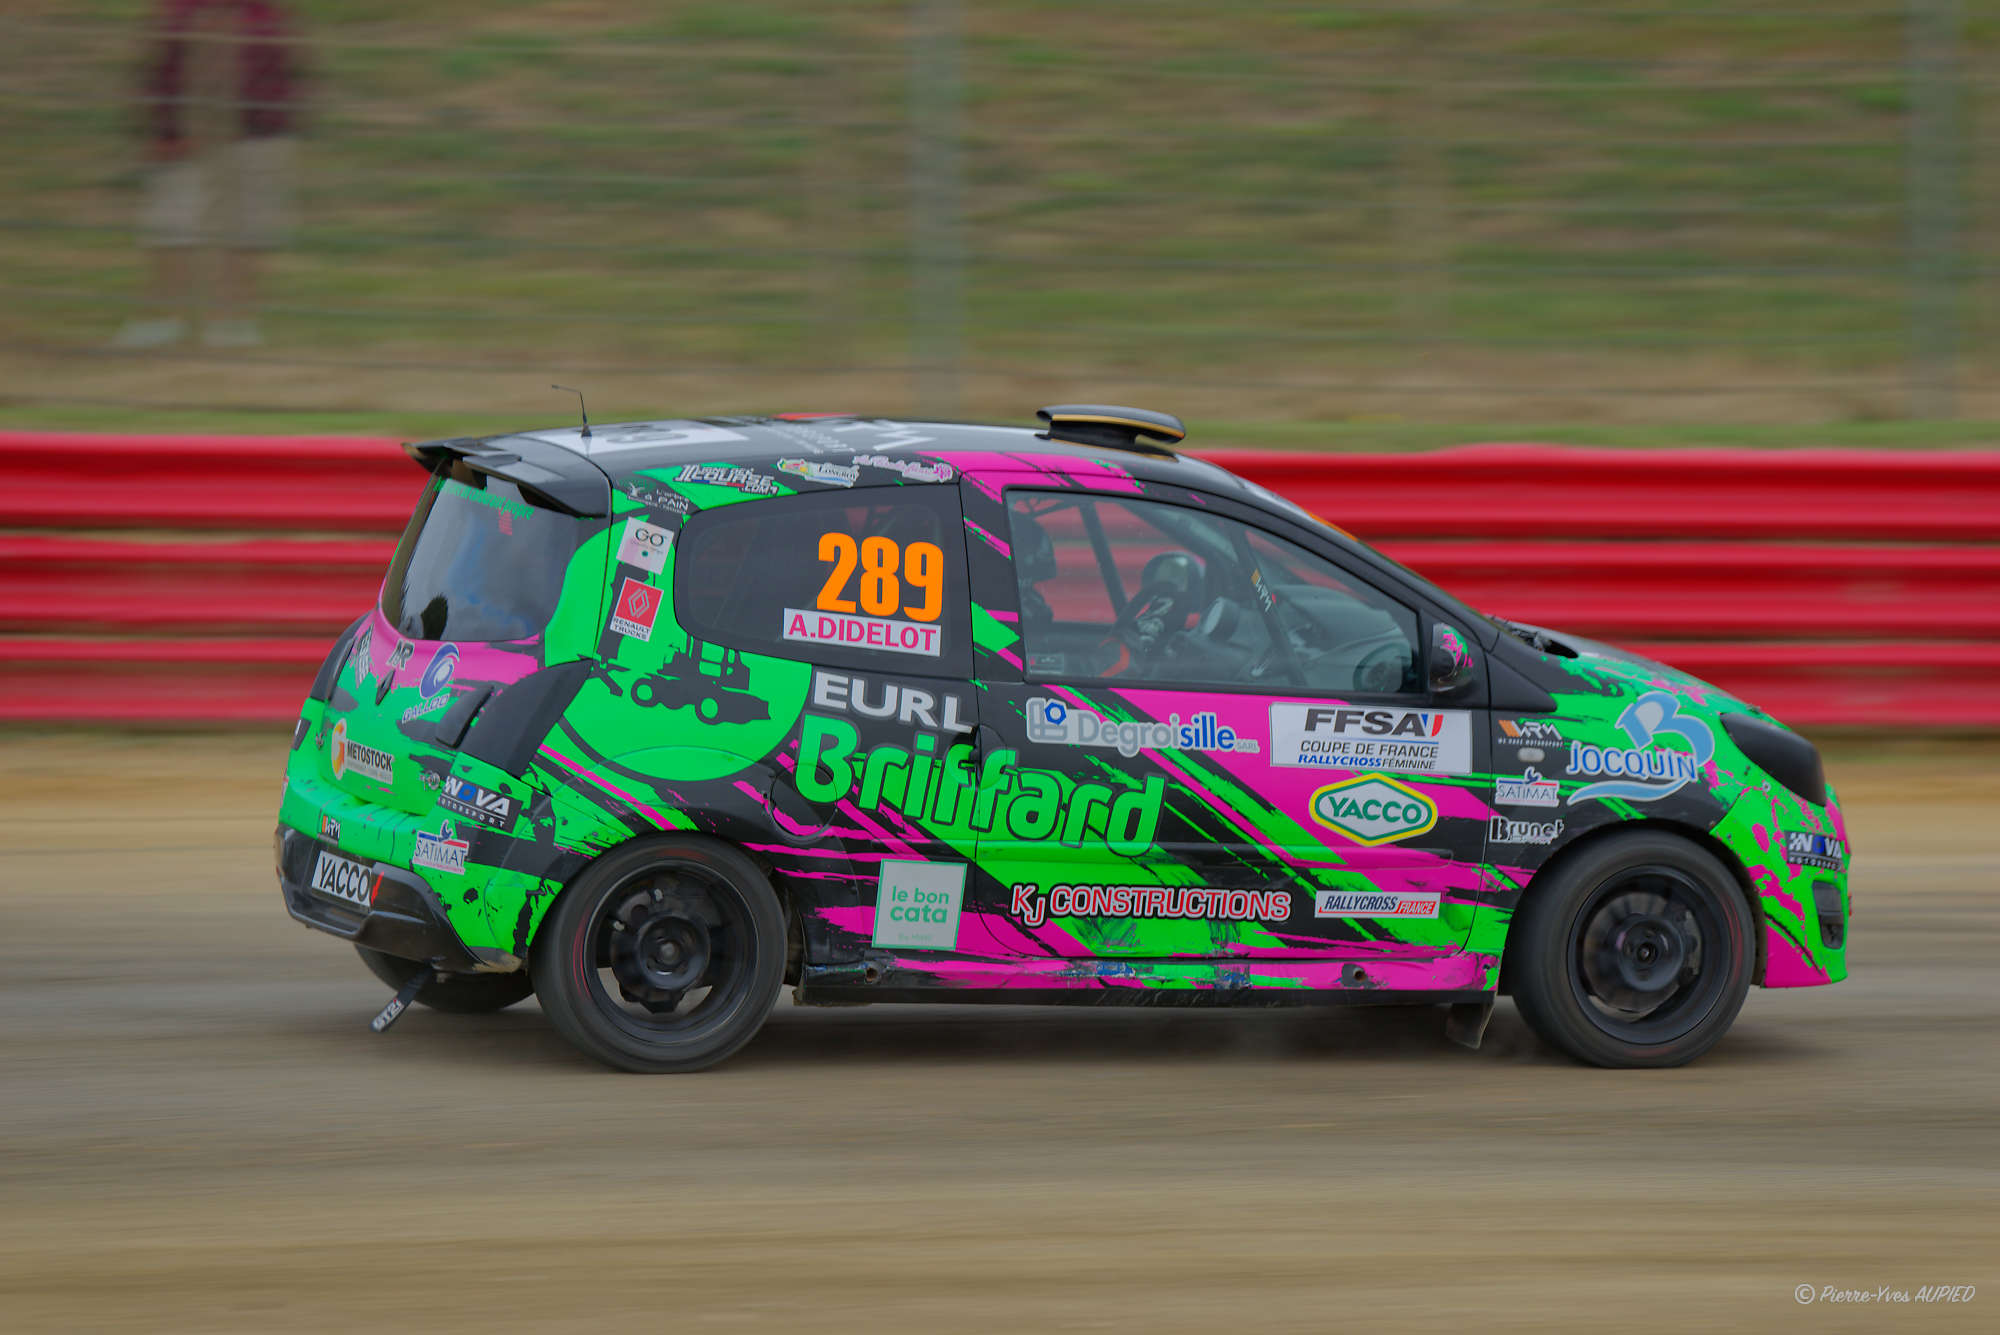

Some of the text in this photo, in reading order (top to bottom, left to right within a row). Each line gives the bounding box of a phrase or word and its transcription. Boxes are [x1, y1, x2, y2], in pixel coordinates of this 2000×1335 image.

[658, 496, 690, 511] PAIN
[635, 528, 665, 546] GO
[817, 532, 943, 622] 289
[613, 617, 650, 633] RENAULT
[613, 624, 647, 640] TRUCKS
[788, 613, 937, 651] A.DIDELOT
[813, 671, 974, 734] EURL
[1077, 713, 1236, 755] Degroisille
[1304, 708, 1426, 737] FFSA
[346, 741, 393, 772] METOSTOCK
[1298, 754, 1383, 768] RALLYCROSS
[1300, 740, 1440, 759] COUPE DE FRANCE
[1566, 741, 1697, 781] JOCQUIN
[445, 776, 510, 816] NOVA
[795, 714, 1166, 858] Briffard
[1497, 783, 1558, 801] SATIMAT
[1328, 796, 1422, 825] YACCO
[415, 839, 467, 868] SATIMAT
[1788, 832, 1842, 858] NOVA
[320, 855, 371, 902] YACCO
[892, 885, 949, 905] le bon
[1012, 885, 1291, 926] KJ CONSTRUCTIONS
[1325, 896, 1435, 914] RALLYCROSS FRANCE
[890, 904, 949, 923] cata
